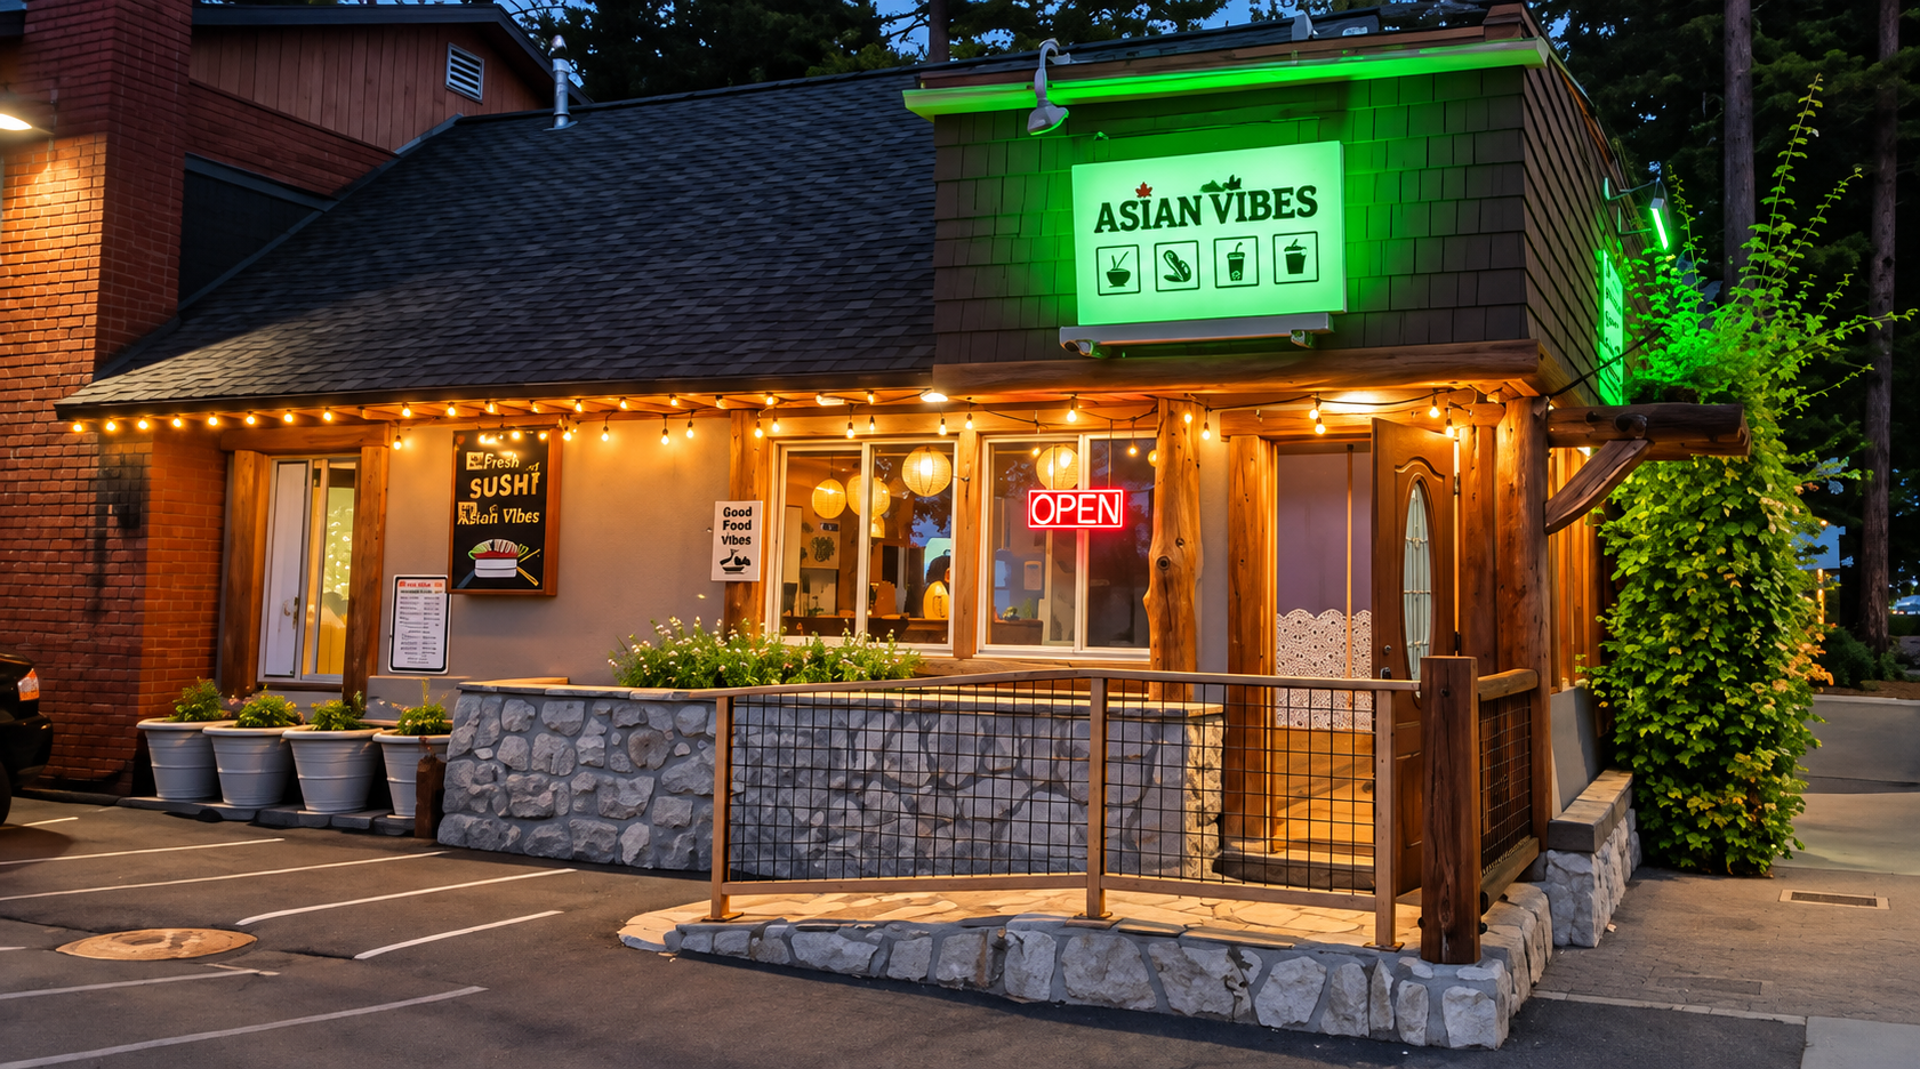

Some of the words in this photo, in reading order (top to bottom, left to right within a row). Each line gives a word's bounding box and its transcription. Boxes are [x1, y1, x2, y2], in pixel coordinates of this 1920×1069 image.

[1094, 195, 1203, 233] ASIAN
[1209, 185, 1319, 225] VIBES
[484, 452, 520, 470] Fresh
[469, 472, 541, 499] SUSHI
[723, 506, 752, 518] Good
[1031, 493, 1120, 525] OPEN
[722, 520, 752, 531] Food
[721, 534, 752, 546] Vibes
